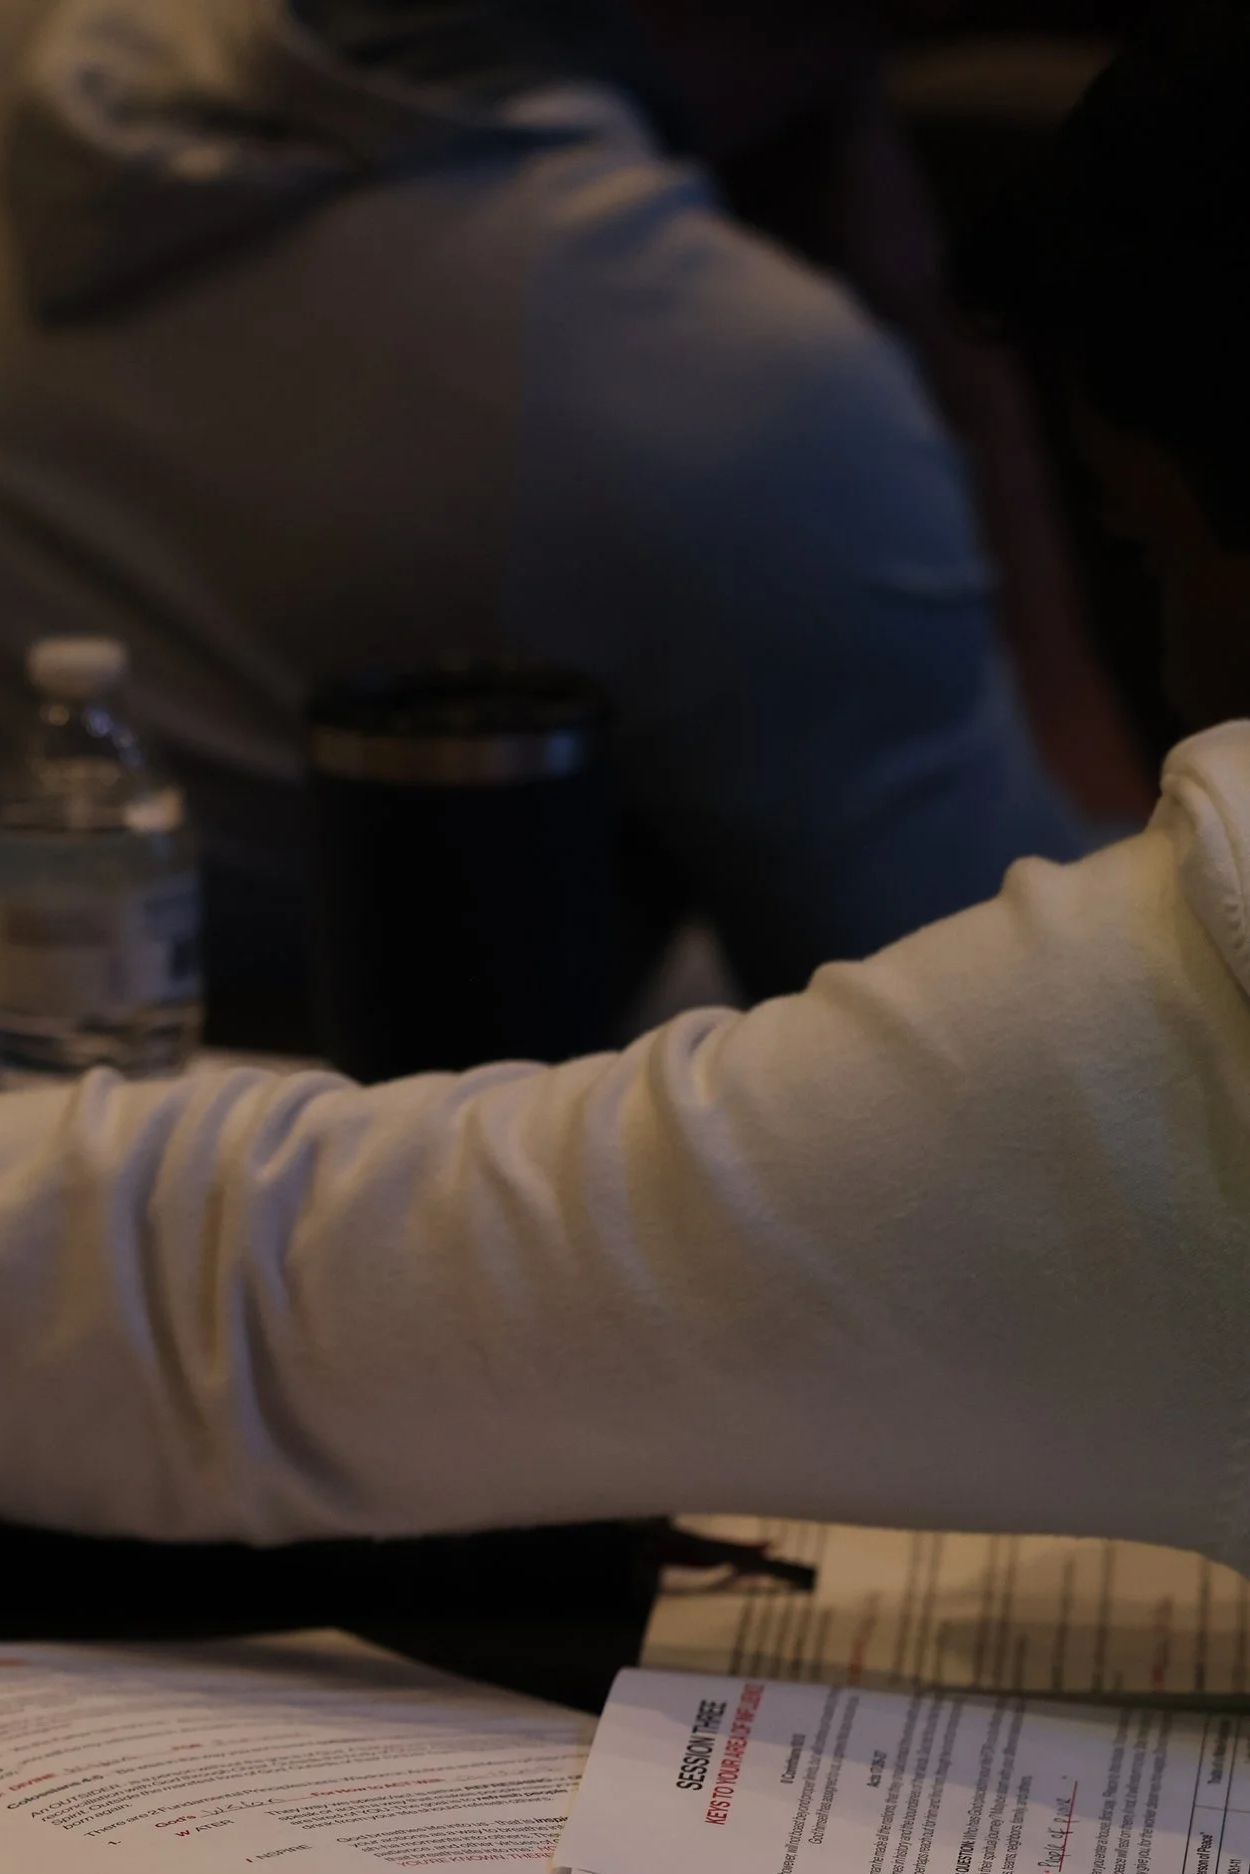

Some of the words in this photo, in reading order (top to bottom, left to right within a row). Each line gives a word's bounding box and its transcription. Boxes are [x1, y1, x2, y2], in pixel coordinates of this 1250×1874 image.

[692, 1699, 727, 1734] THREE
[676, 1737, 717, 1791] SESSION
[717, 1758, 743, 1787] YOUR
[712, 1785, 735, 1800] TO
[63, 1816, 94, 1830] born
[155, 1815, 196, 1828] God's
[705, 1800, 732, 1826] KEYS
[83, 1820, 126, 1837] There
[955, 1841, 975, 1873] QUESTION:
[1228, 1859, 1242, 1874] 10:1-11
